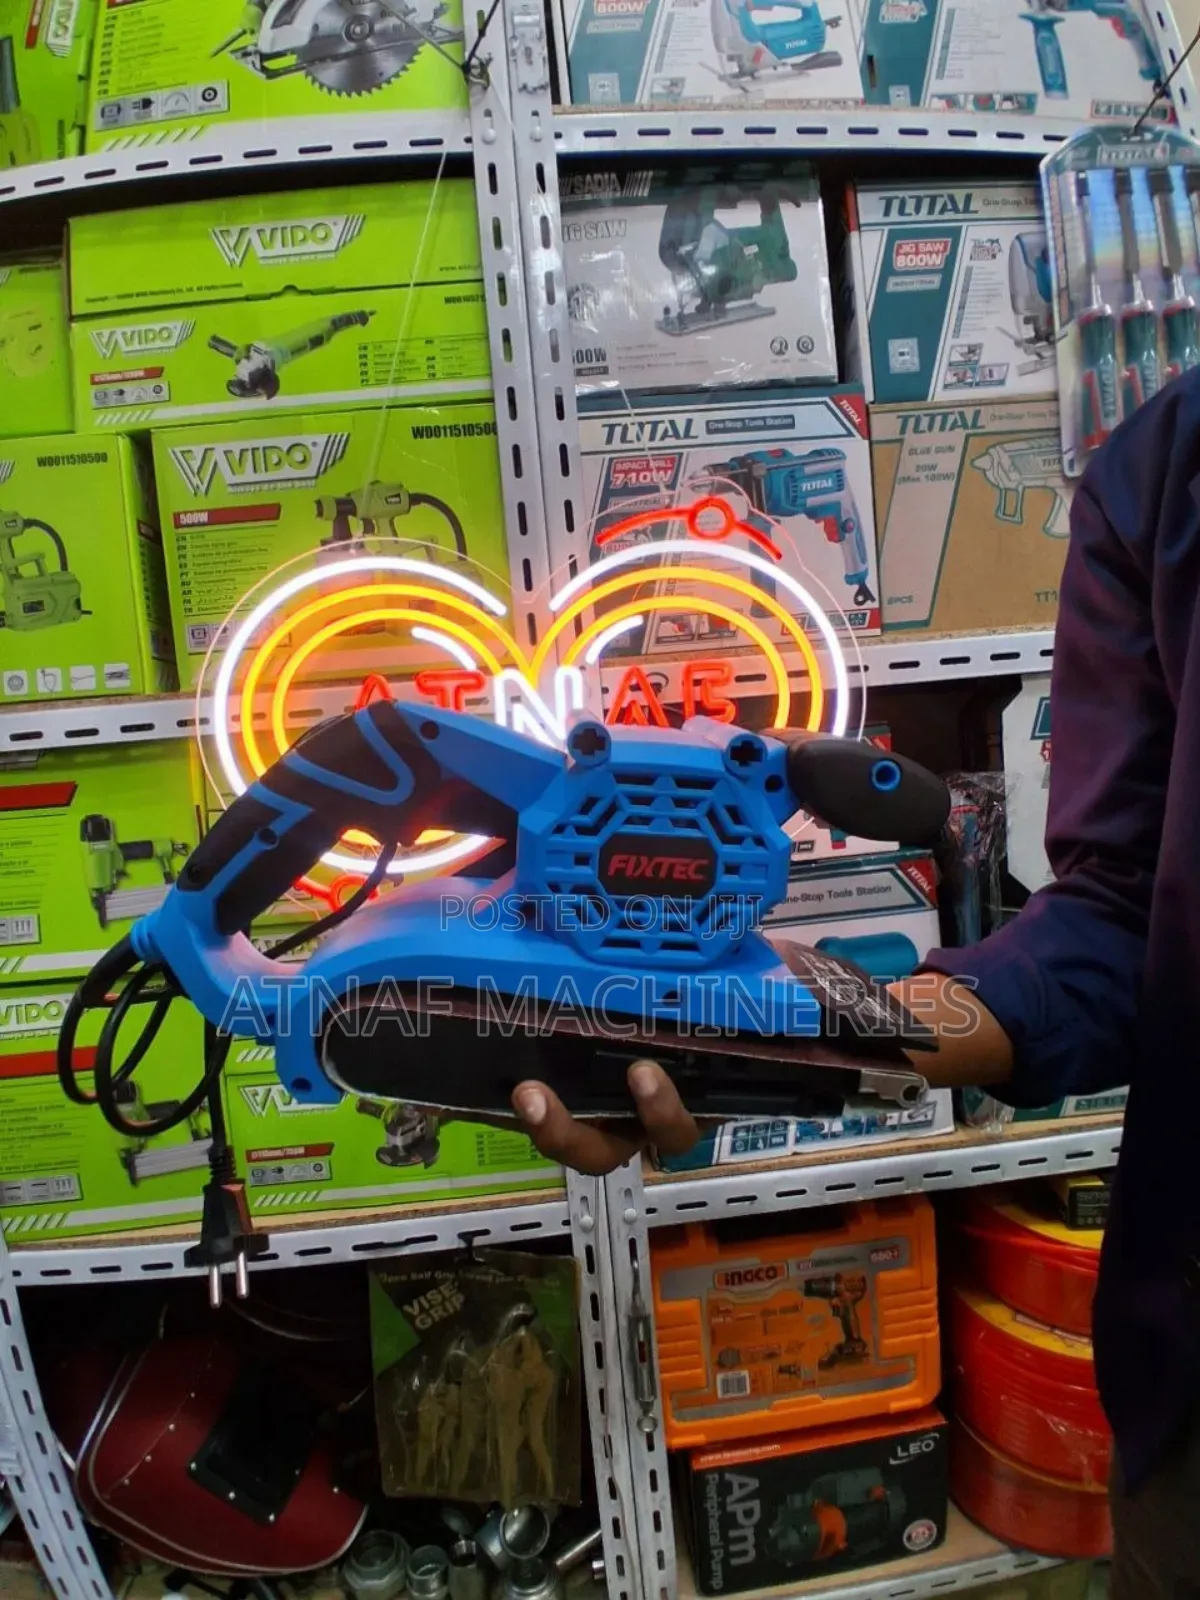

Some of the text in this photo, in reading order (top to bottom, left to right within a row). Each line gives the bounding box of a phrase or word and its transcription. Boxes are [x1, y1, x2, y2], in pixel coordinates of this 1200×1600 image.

[879, 193, 979, 217] TOTAL
[257, 222, 334, 249] VIDO
[896, 253, 942, 267] 800W
[122, 327, 172, 347] VIDO
[602, 418, 698, 445] TOTAL
[897, 410, 985, 435] TOTAL
[223, 442, 312, 475] VIDO
[613, 470, 673, 487] 710W
[179, 511, 208, 524] 500W
[608, 854, 709, 880] FIXTEC
[828, 889, 853, 900] Tools
[855, 885, 892, 897] Station
[402, 1281, 458, 1317] VISE
[414, 1294, 466, 1331] GRIP
[897, 1440, 935, 1458] LEO
[725, 1472, 761, 1567] APm
